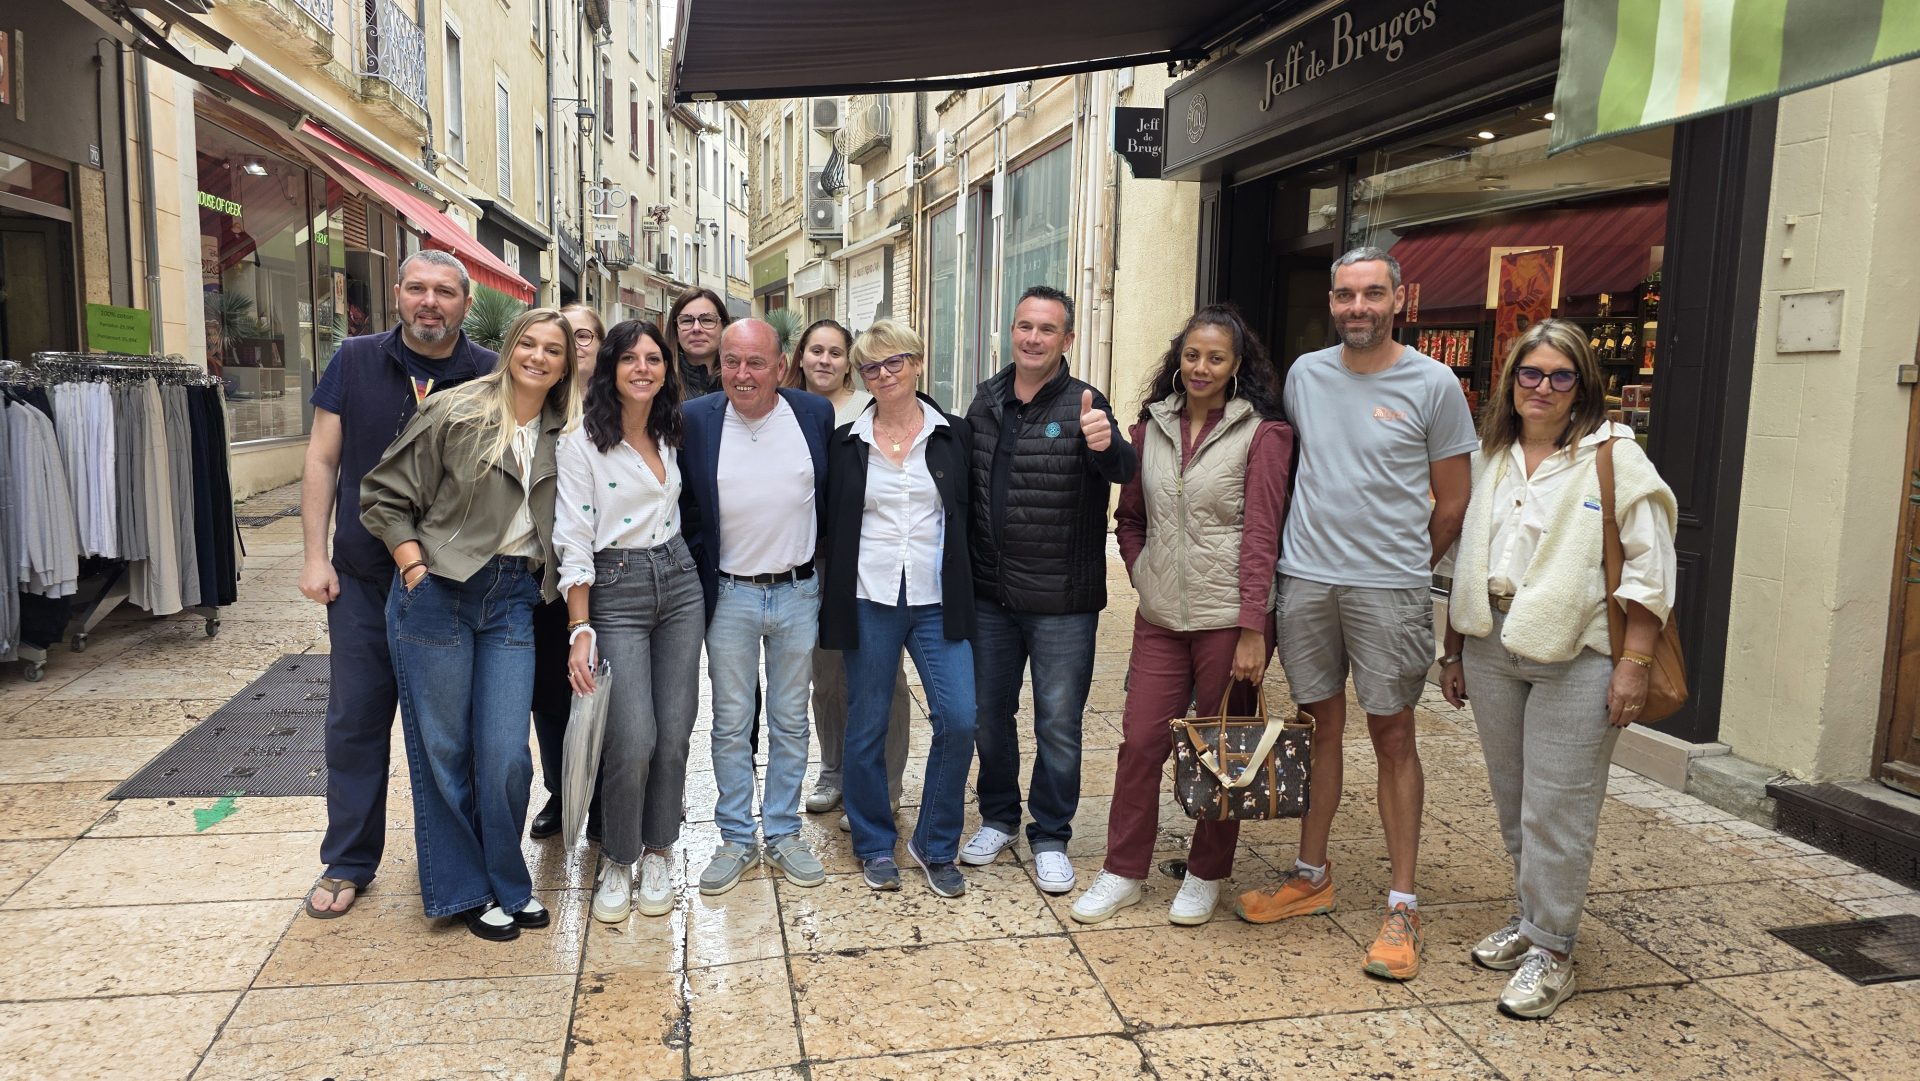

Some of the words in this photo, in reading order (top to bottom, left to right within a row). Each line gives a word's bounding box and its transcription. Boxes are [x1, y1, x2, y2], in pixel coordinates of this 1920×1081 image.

[1259, 41, 1304, 112] Jeff
[1305, 51, 1325, 81] de
[1327, 0, 1437, 72] Bruges
[1136, 117, 1160, 133] Jeff
[1143, 132, 1153, 141] de
[1127, 138, 1162, 157] Bruge
[216, 197, 225, 211] OF
[225, 200, 242, 217] GEEK
